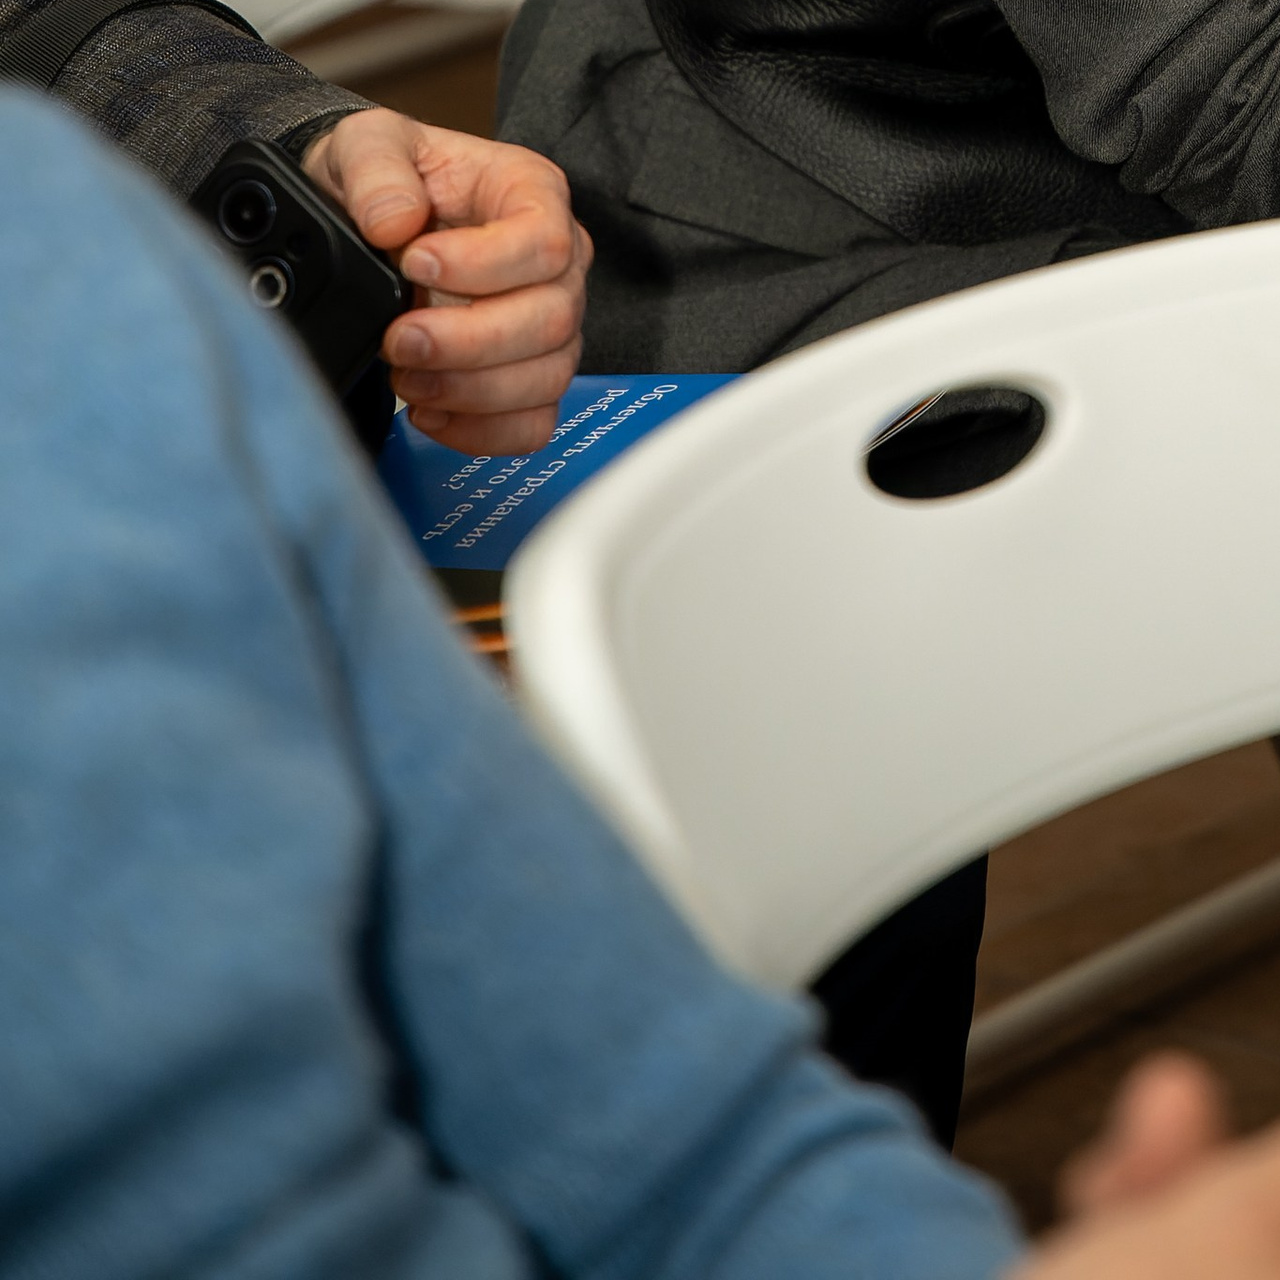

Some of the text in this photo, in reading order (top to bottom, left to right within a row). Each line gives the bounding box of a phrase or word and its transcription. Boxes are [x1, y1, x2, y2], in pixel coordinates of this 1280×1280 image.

[454, 384, 679, 549] Облегчить страдания
[488, 457, 530, 485] это
[469, 488, 493, 500] и
[422, 503, 474, 541] есть
